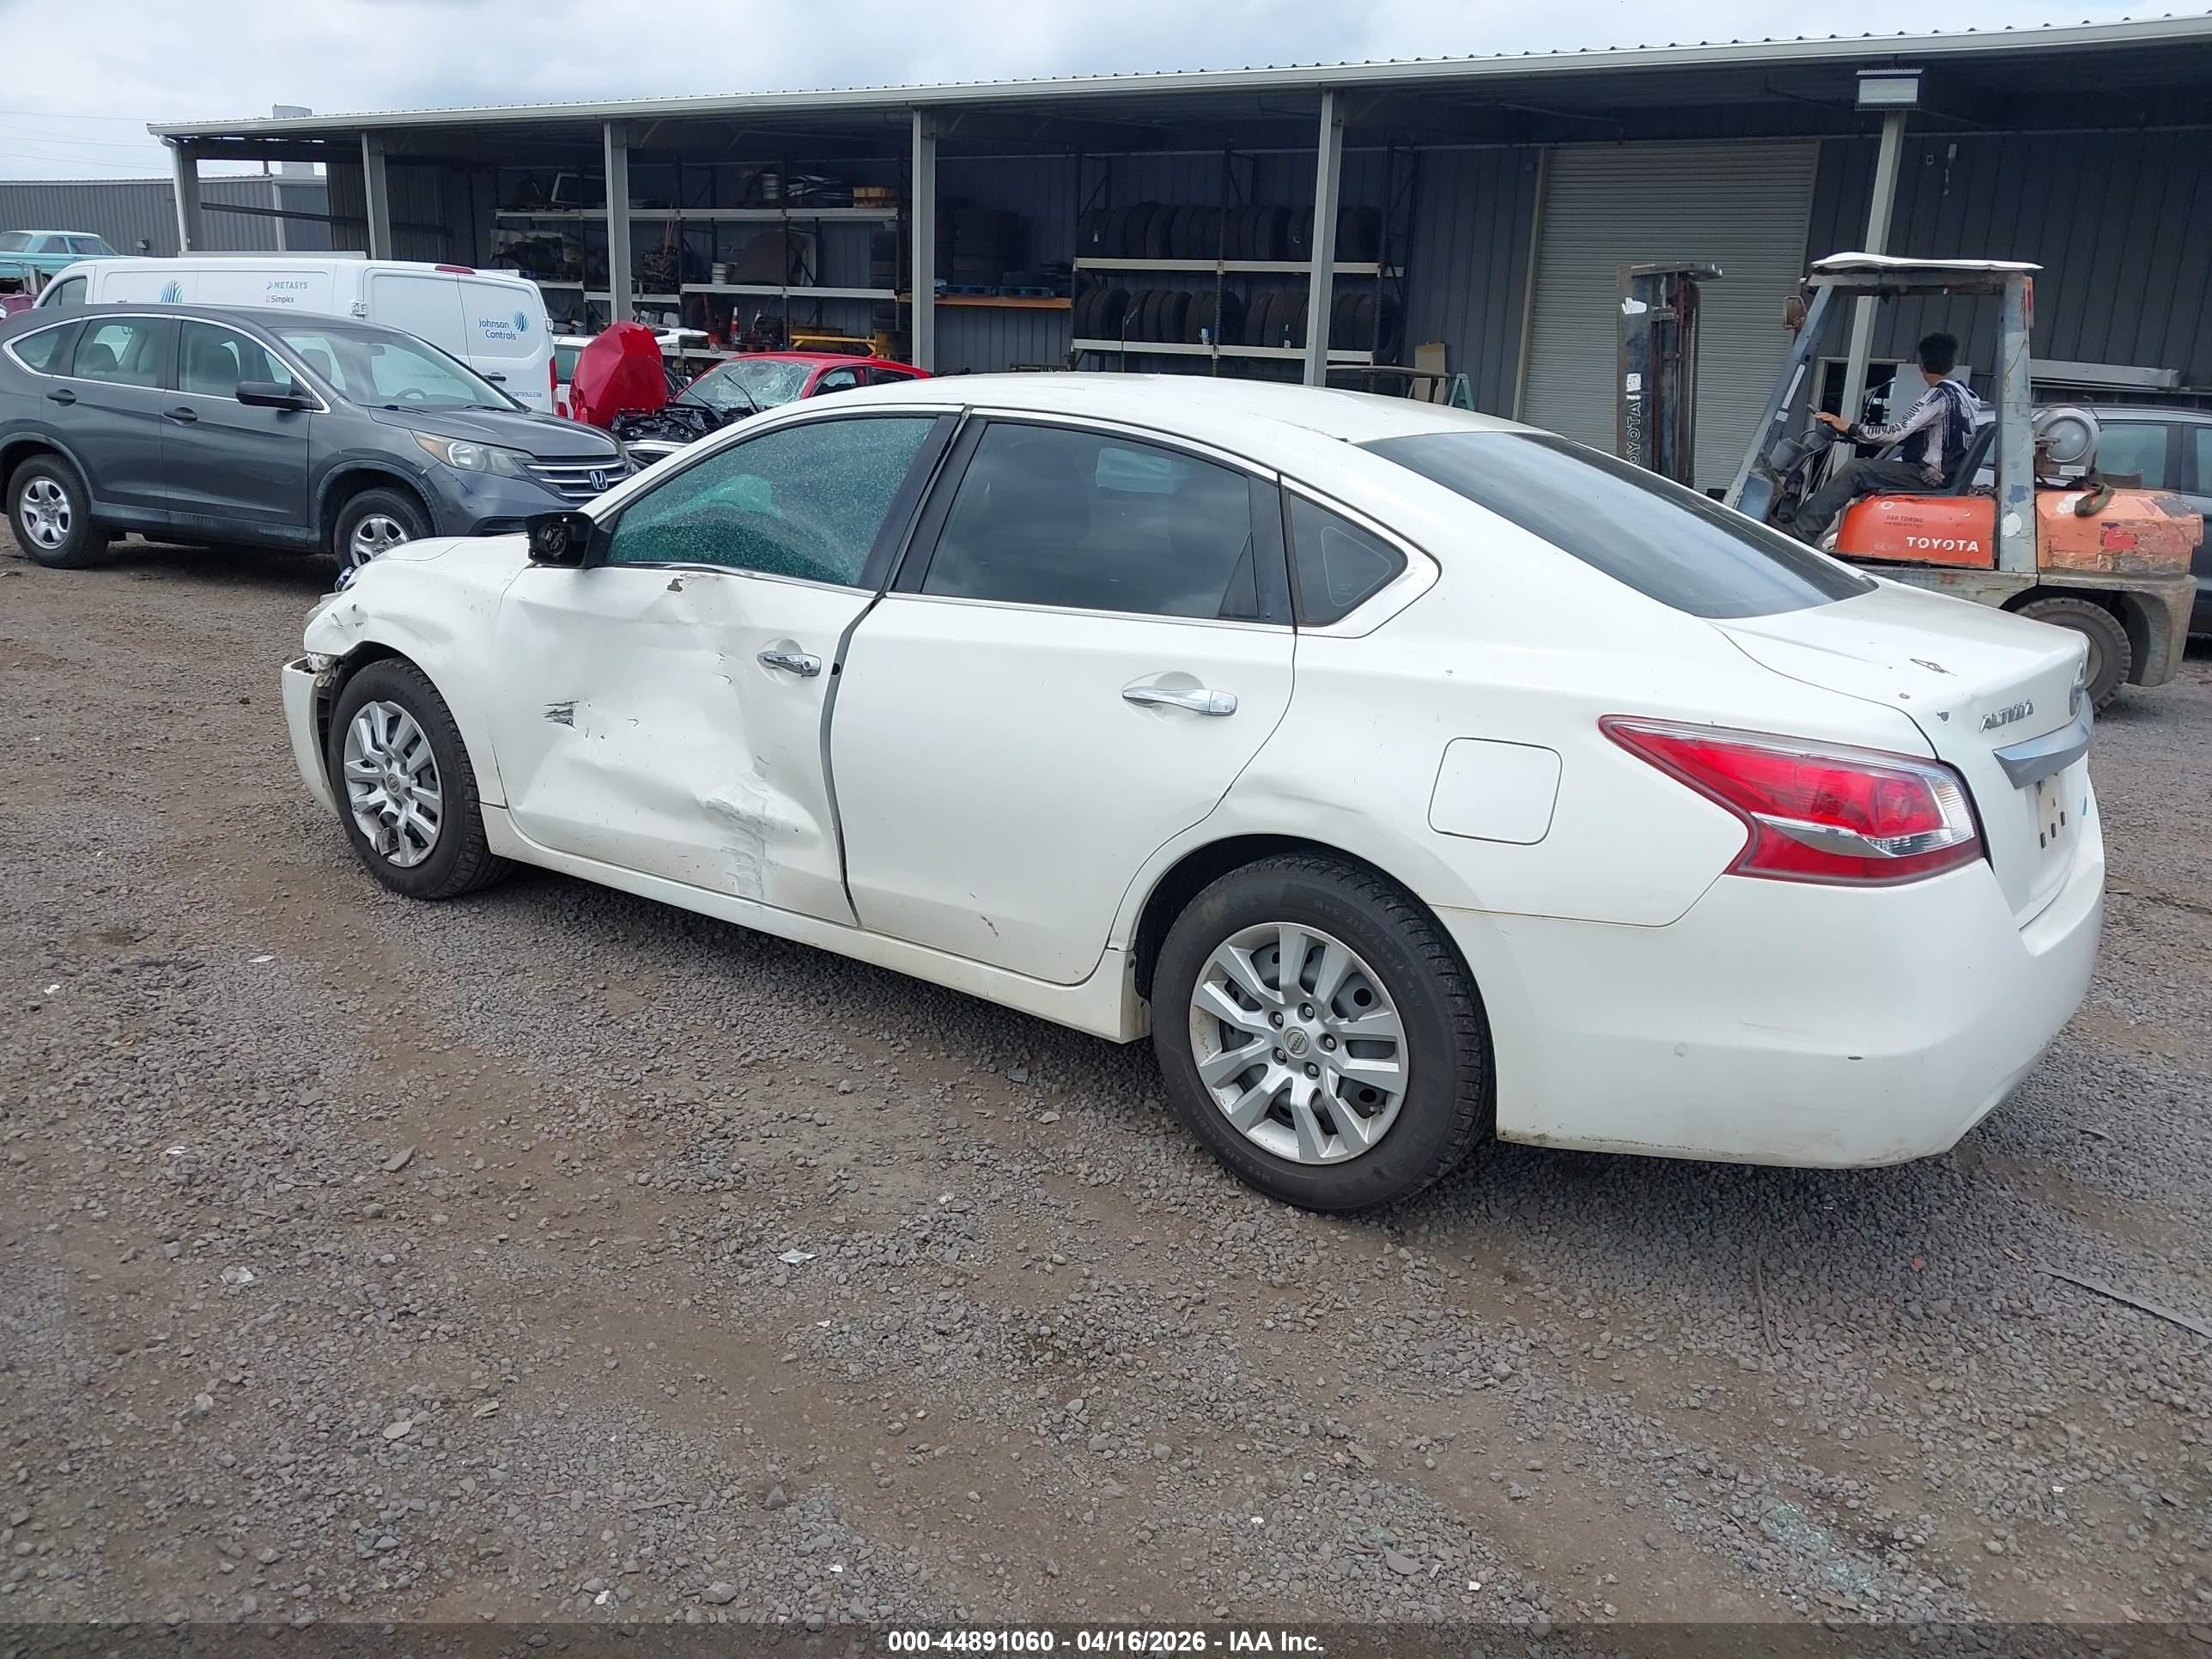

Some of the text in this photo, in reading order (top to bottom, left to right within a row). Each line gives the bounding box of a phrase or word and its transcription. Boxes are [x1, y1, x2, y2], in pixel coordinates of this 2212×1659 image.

[270, 295, 295, 305] Simplex
[478, 318, 509, 329] Johnson
[485, 329, 516, 340] Controls
[1626, 401, 1641, 465] OYOTA
[1906, 536, 1979, 553] TOYOTA
[1979, 699, 2034, 733] ALTIMA
